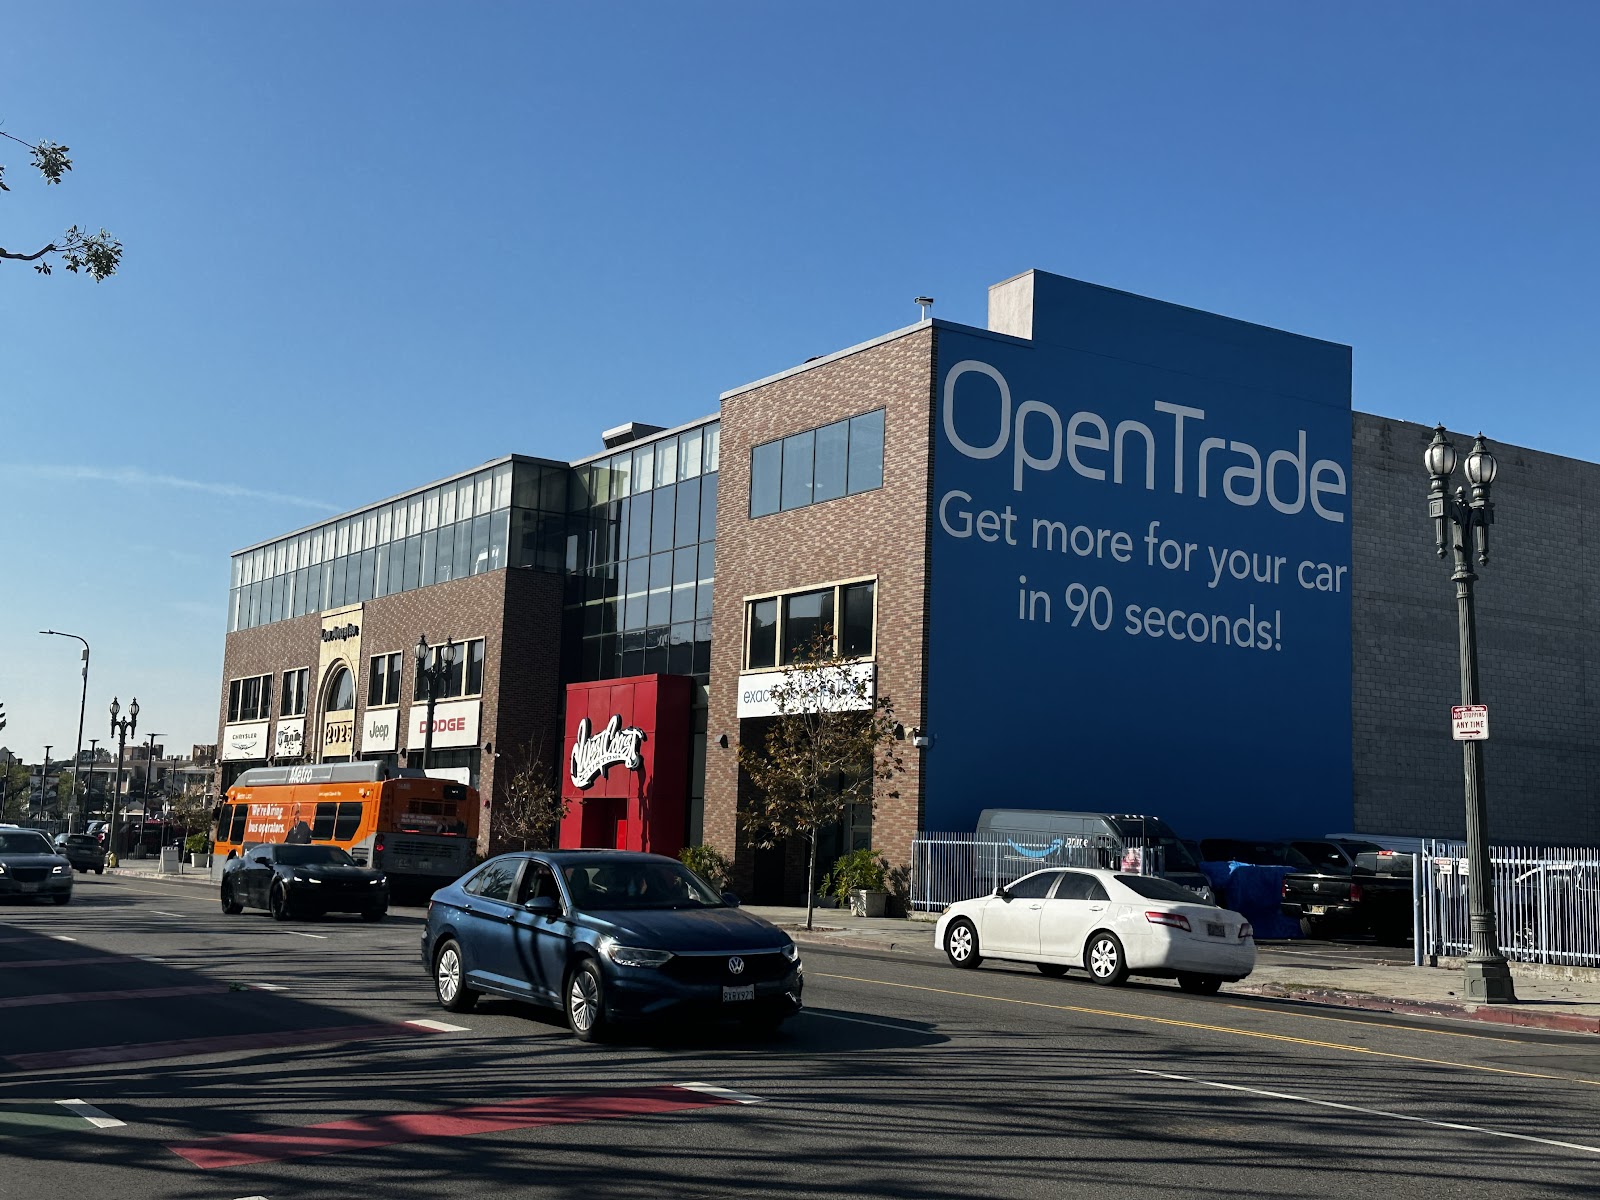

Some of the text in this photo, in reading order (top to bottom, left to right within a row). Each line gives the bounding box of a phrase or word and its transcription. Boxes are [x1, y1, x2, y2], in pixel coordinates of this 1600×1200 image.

[942, 359, 1347, 523] OpenTrade
[938, 489, 1348, 593] Get more for your car
[1018, 575, 1282, 652] in 90 seconds!
[369, 721, 389, 741] Jeep
[1456, 720, 1484, 729] ANY TIME
[232, 732, 257, 740] CHRYSLER
[288, 765, 313, 784] Metro
[252, 803, 283, 820] We're hiring
[248, 820, 258, 833] bus
